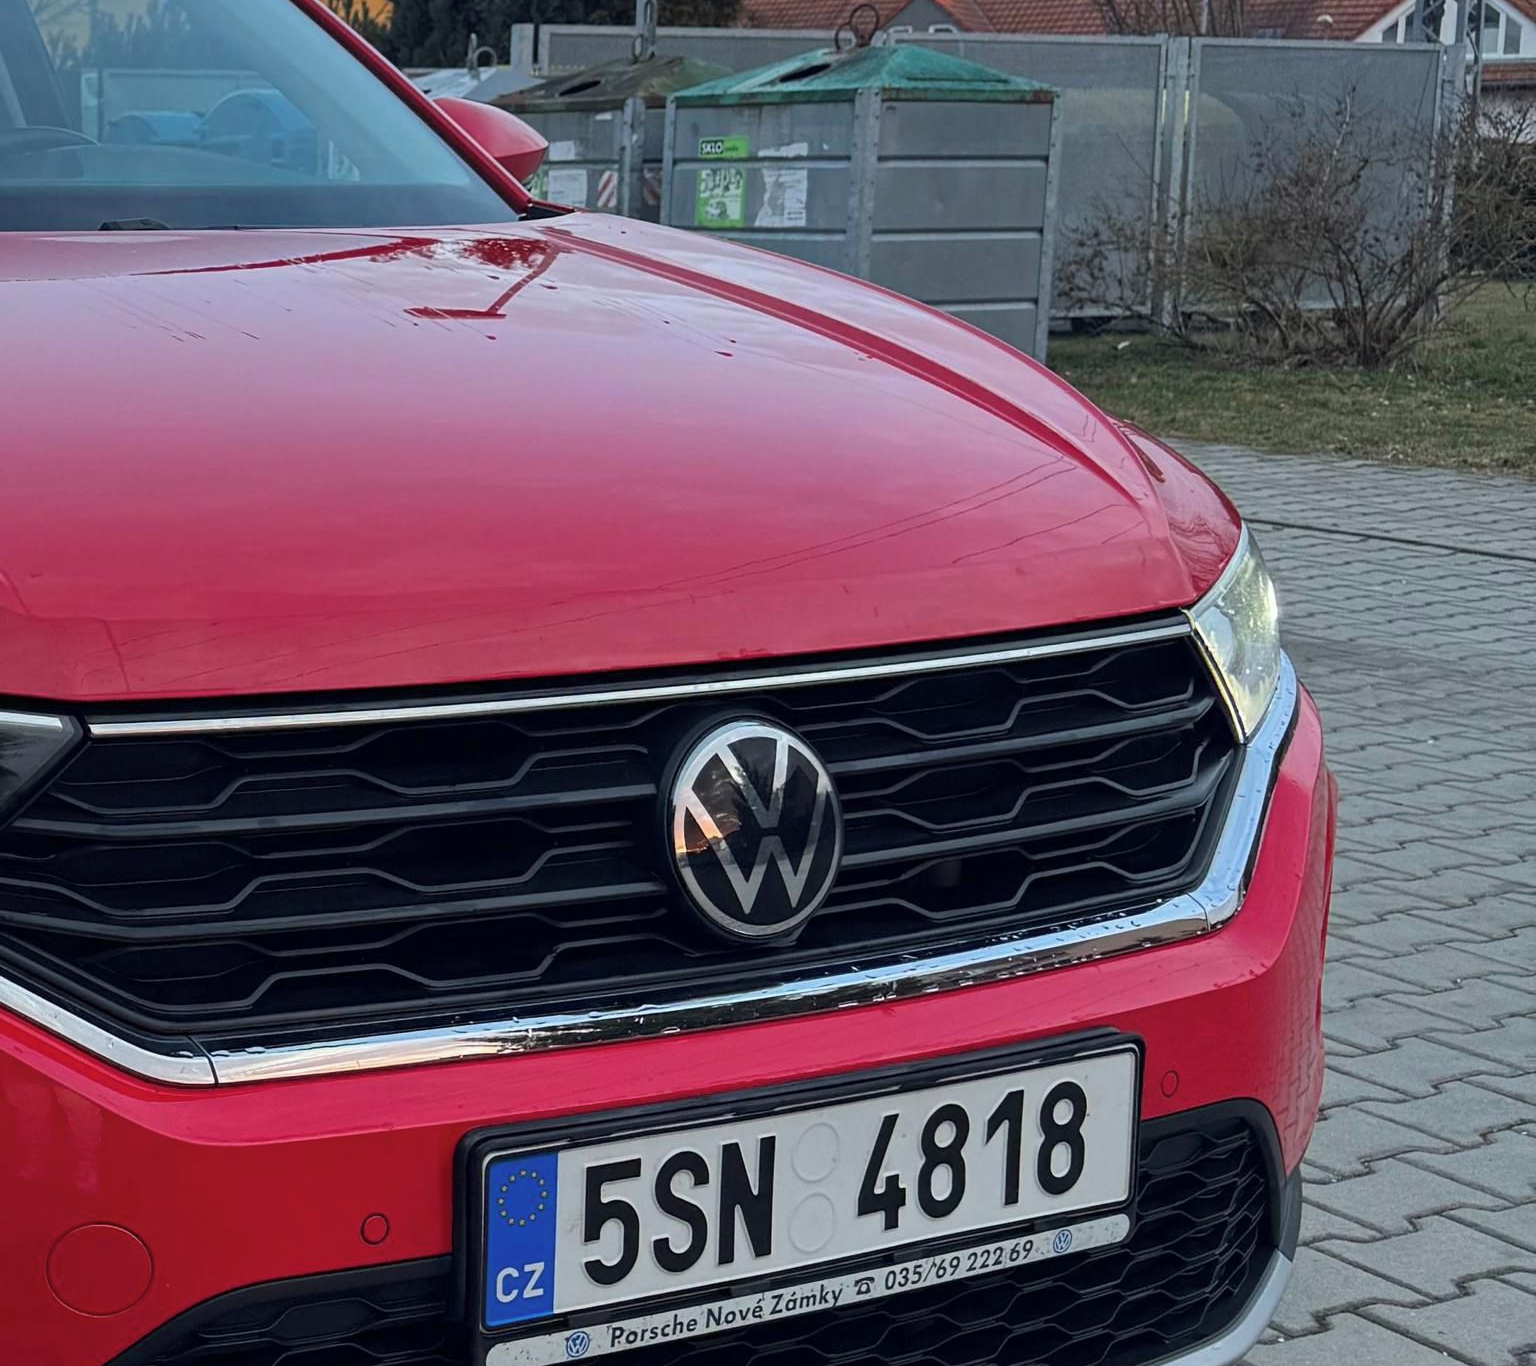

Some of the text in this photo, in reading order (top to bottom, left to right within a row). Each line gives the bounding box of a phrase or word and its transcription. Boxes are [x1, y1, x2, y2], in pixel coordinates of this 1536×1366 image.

[583, 1081, 1088, 1286] 5SN 4818
[495, 1261, 544, 1304] CZ
[609, 1313, 697, 1348] Porsche
[705, 1298, 764, 1328] Nové
[769, 1279, 844, 1315] Zámky
[884, 1255, 961, 1291] 035/69
[966, 1246, 1005, 1272] 222
[1008, 1239, 1034, 1262] 69
